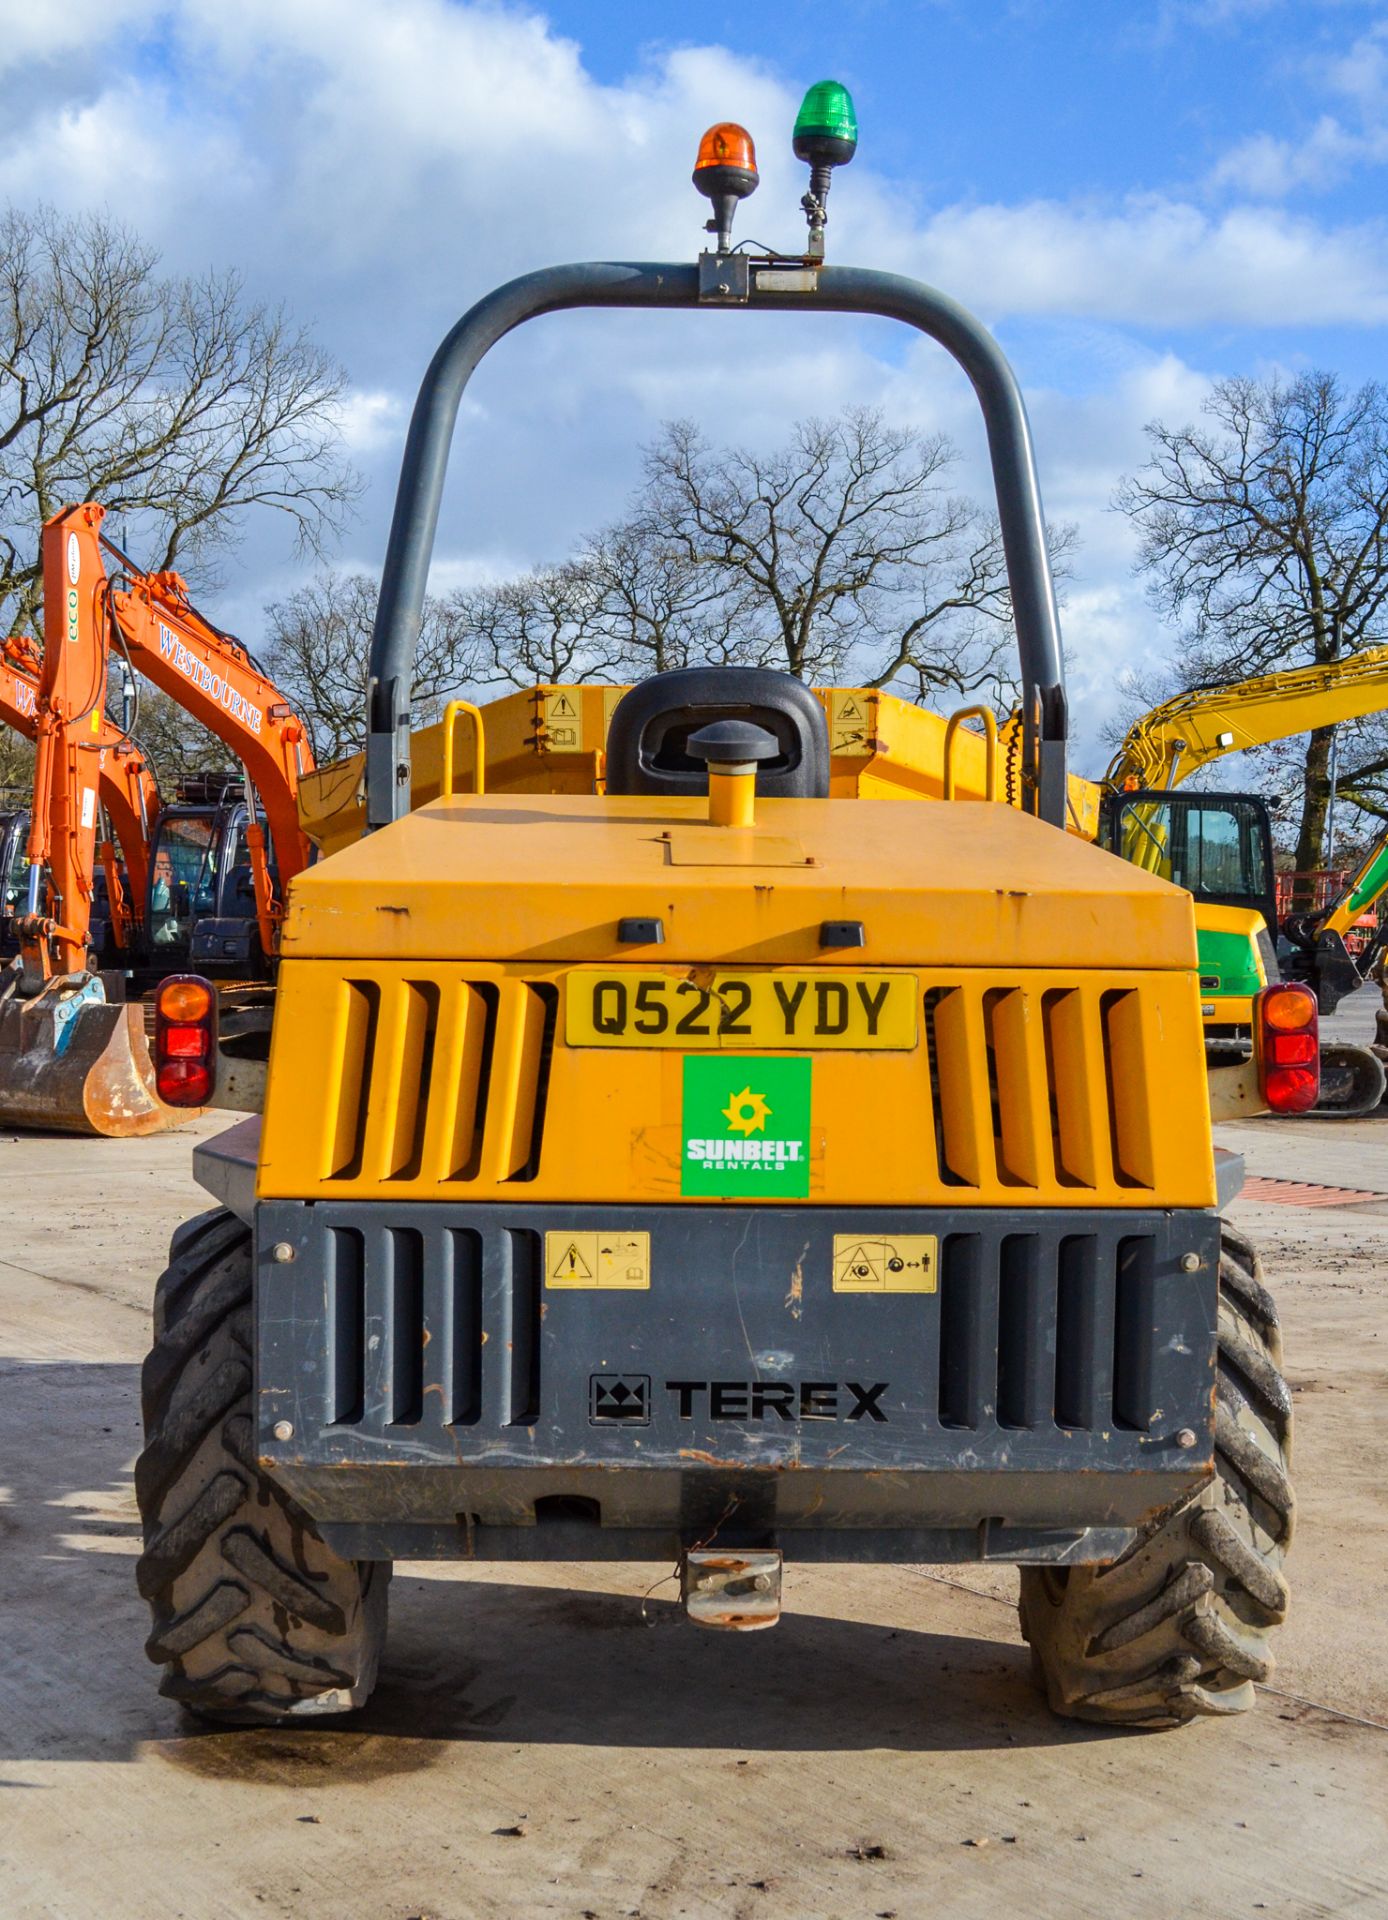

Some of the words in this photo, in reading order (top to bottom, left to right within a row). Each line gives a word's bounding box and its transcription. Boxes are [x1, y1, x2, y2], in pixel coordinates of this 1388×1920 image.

[69, 591, 78, 641] eco
[159, 621, 263, 735] WESTBOURNE
[592, 980, 752, 1036] Q522
[773, 981, 891, 1036] YDY
[687, 1139, 803, 1162] SUNBELT
[703, 1161, 785, 1171] RENTALS
[665, 1381, 890, 1422] TEREX
